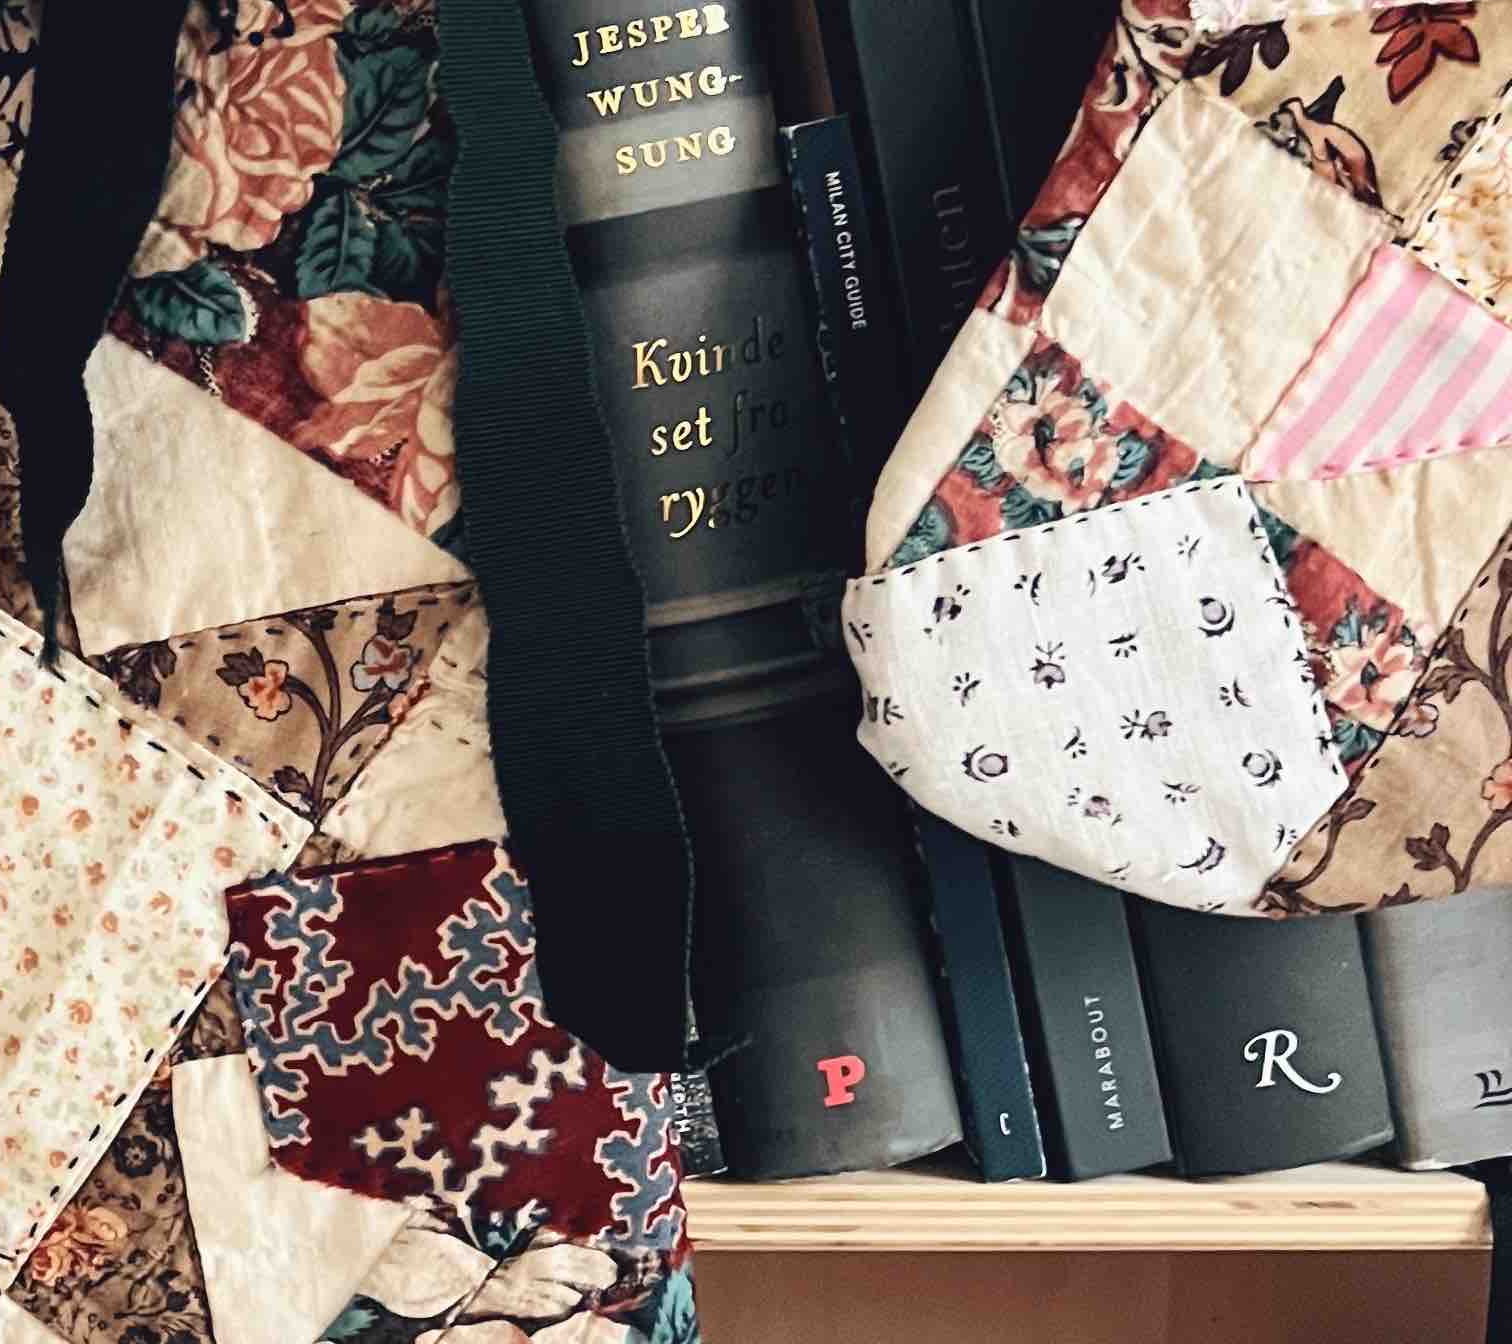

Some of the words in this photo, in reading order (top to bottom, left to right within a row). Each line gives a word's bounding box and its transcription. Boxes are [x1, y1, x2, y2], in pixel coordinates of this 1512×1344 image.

[571, 3, 730, 67] JESPER
[586, 65, 744, 117] WUNG-
[615, 126, 736, 176] SUNG
[825, 170, 848, 227] MILAN
[836, 231, 856, 270] CITY
[845, 276, 867, 330] GUIDE
[631, 315, 785, 390] Kvinde
[651, 406, 713, 456] set
[816, 1055, 866, 1108] P
[1084, 994, 1125, 1132] MARABOUT
[1243, 1029, 1343, 1095] R
